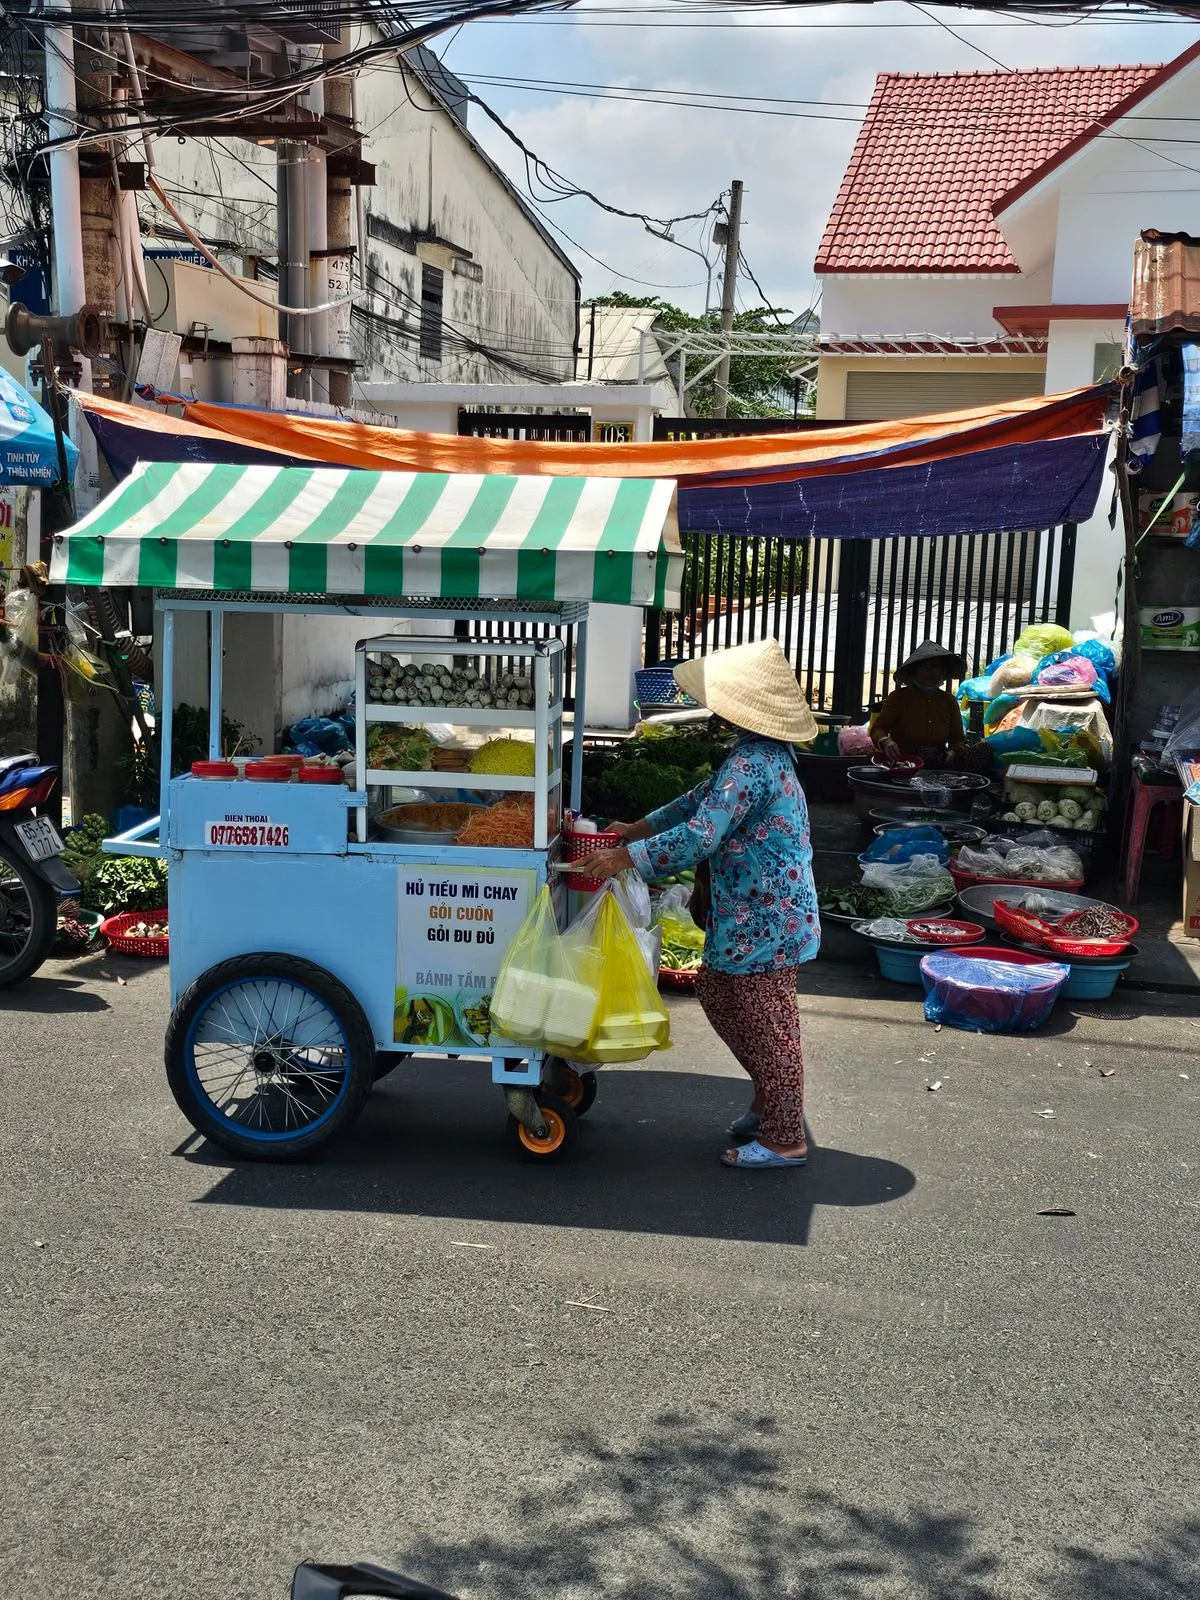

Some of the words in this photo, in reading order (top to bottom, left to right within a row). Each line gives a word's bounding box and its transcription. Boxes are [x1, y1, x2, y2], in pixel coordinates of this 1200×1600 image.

[1155, 612, 1174, 622] Ami
[210, 825, 289, 846] 0776587426
[31, 835, 61, 857] 1774
[406, 878, 424, 896] HỦ
[428, 880, 458, 898] TIẾU
[462, 882, 479, 899] MÌ
[483, 886, 518, 900] CHAY
[429, 902, 452, 920] GỎI
[456, 904, 494, 922] CUỐN
[427, 924, 450, 942] GỎI
[454, 929, 472, 943] ĐU
[476, 926, 495, 944] ĐỦ
[416, 970, 453, 987] BÁNH
